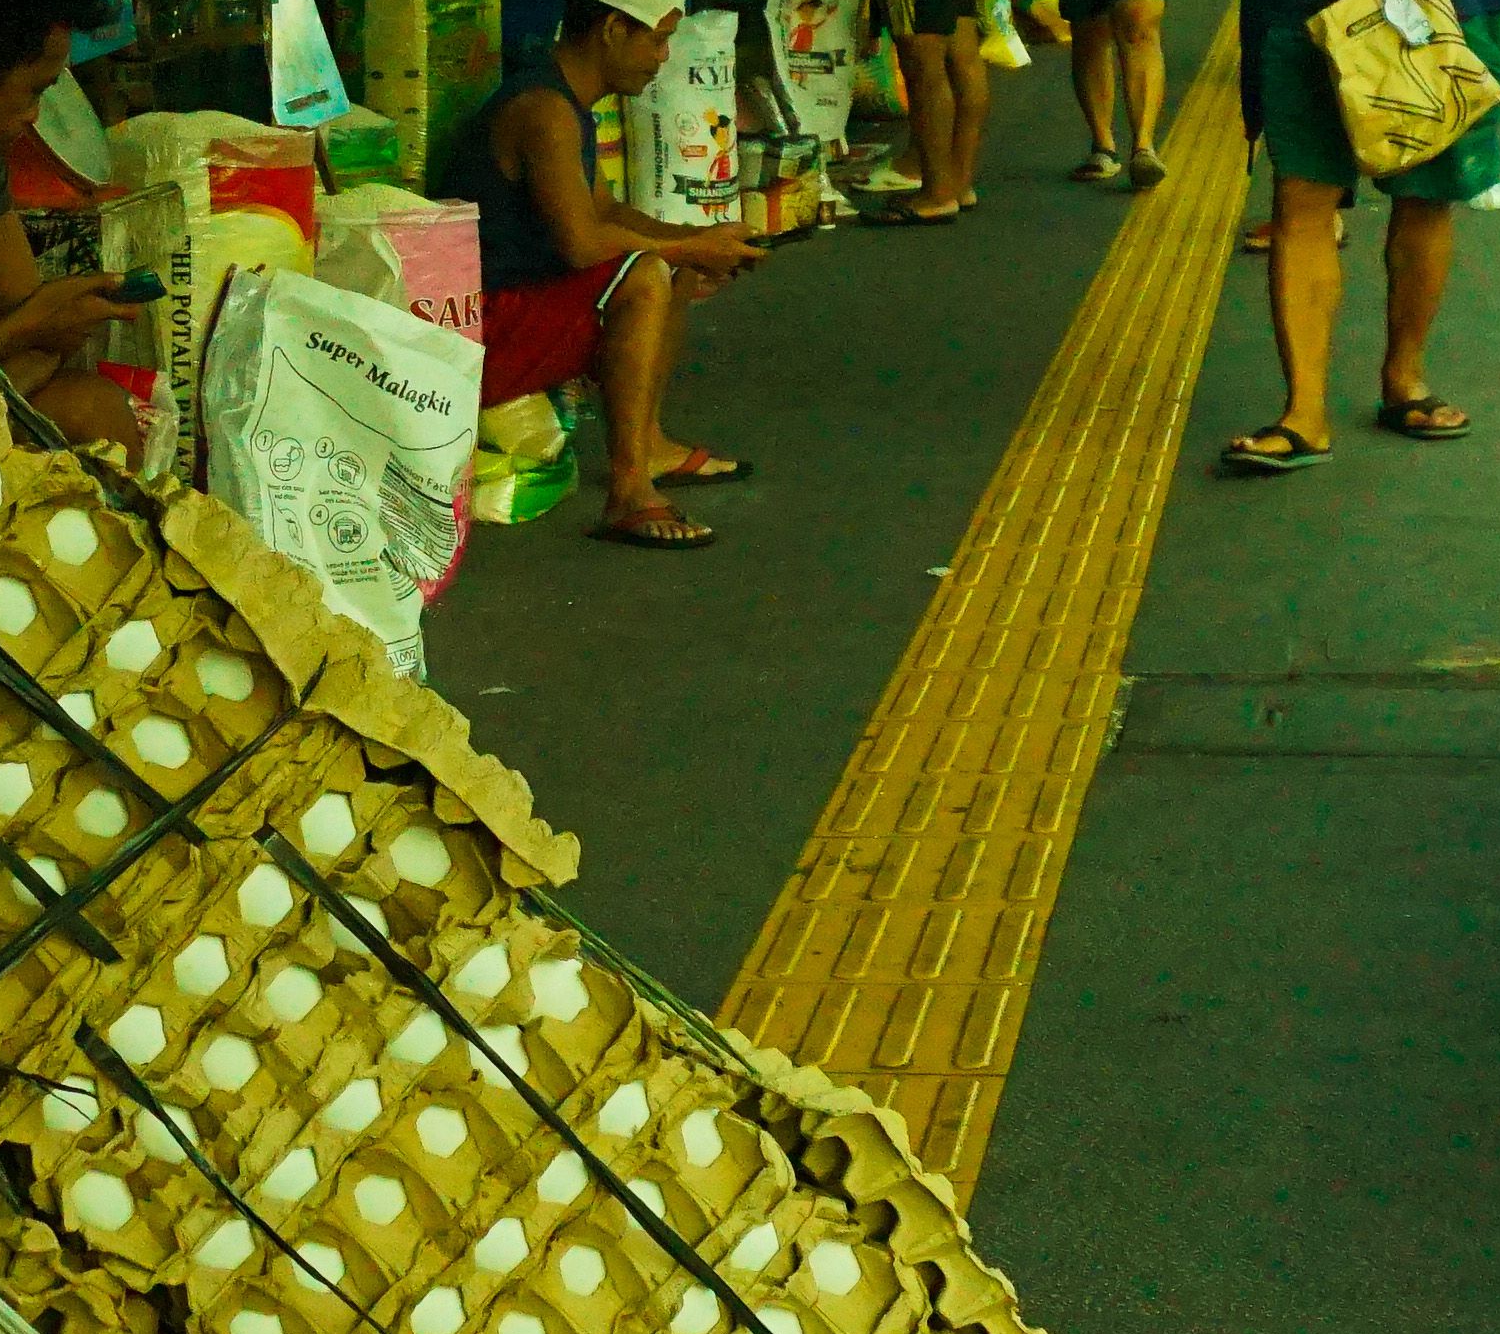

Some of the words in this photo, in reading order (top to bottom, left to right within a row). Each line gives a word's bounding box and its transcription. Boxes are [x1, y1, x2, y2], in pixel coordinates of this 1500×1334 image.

[171, 234, 192, 286] THE
[171, 293, 192, 390] POTALA
[305, 331, 365, 369] Super
[364, 362, 452, 417] Malagkit
[320, 442, 328, 454] 3
